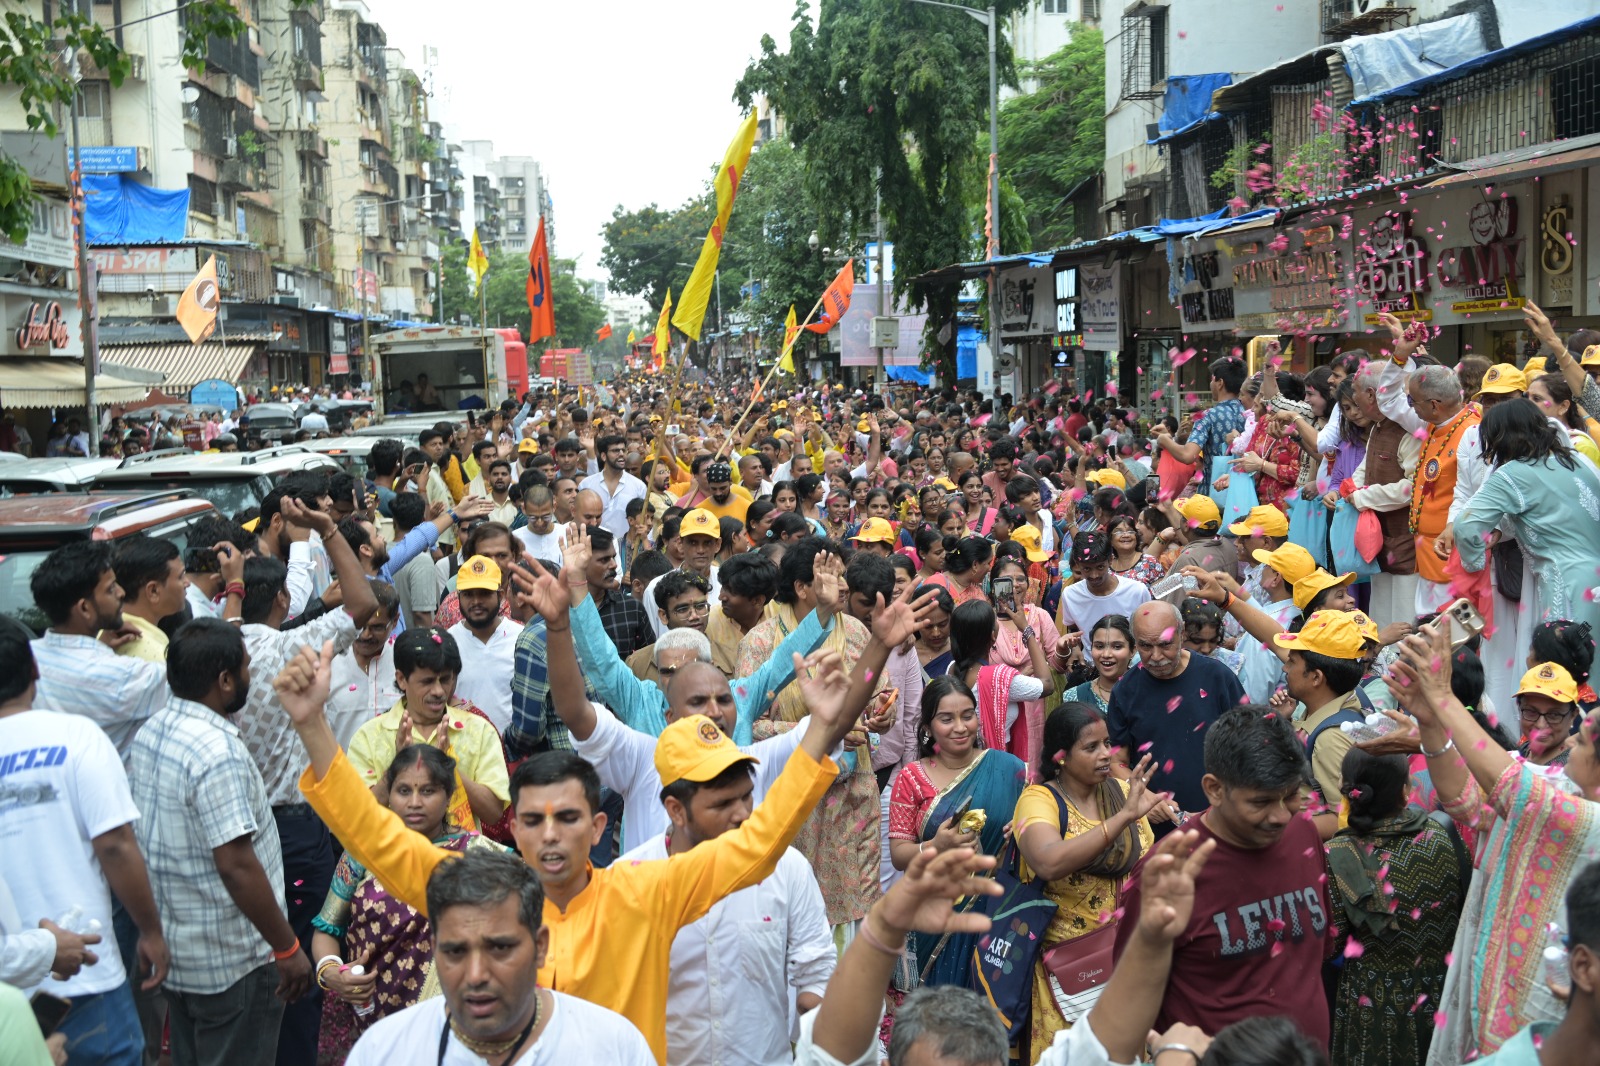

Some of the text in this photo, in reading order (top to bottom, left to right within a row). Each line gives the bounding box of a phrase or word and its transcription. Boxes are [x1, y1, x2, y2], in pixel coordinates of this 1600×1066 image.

[121, 250, 161, 270] SPA
[1437, 239, 1524, 288] CAMY
[1057, 302, 1076, 332] CASE
[1213, 886, 1327, 956] LEVI'S
[988, 937, 1011, 958] ART
